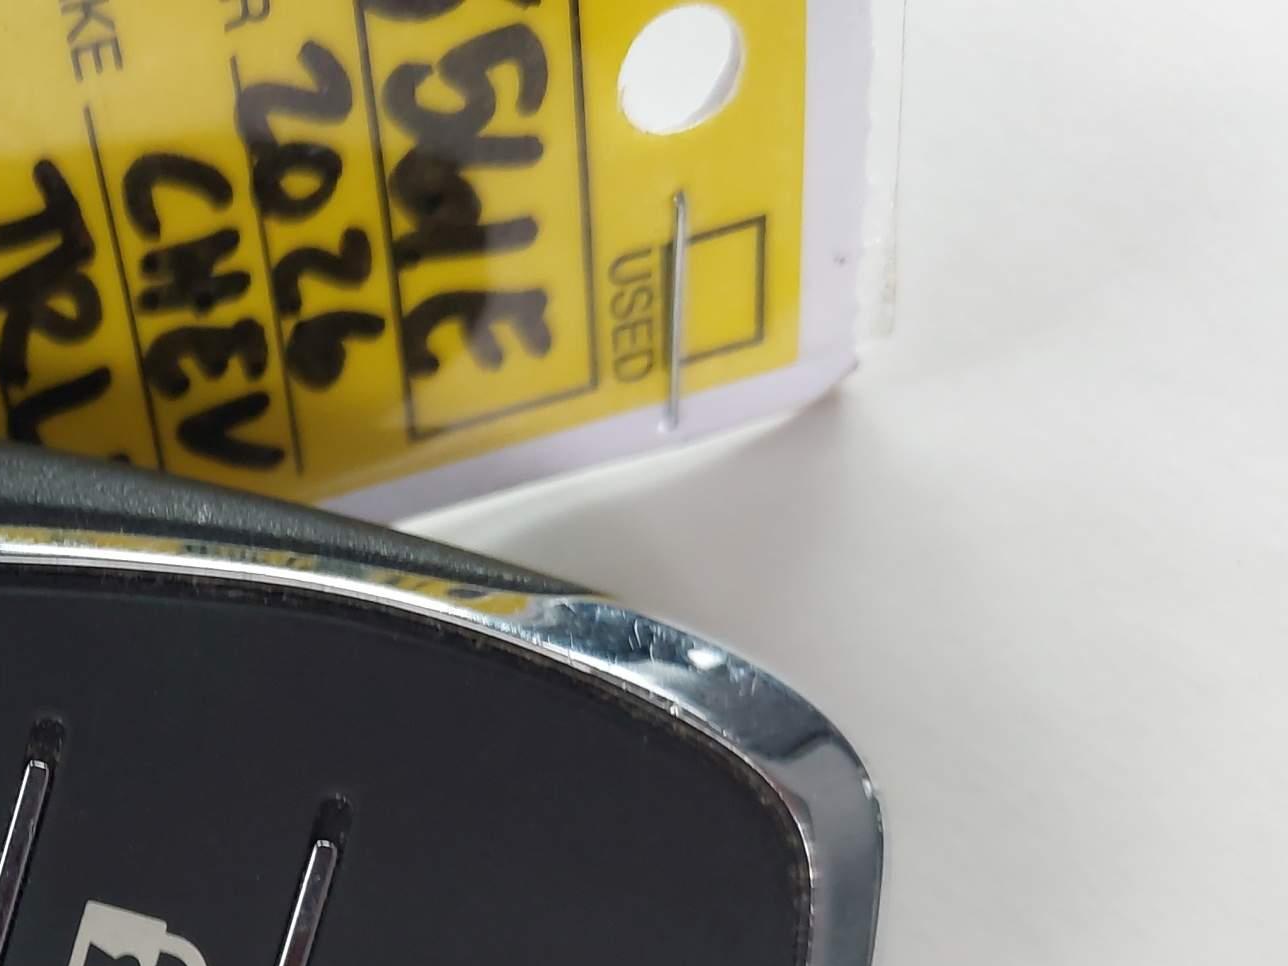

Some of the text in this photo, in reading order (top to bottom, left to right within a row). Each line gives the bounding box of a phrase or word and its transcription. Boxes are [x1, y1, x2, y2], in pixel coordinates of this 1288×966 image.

[60, 0, 123, 83] KE
[121, 151, 285, 469] CHEV
[234, 40, 386, 391] 2026
[608, 246, 654, 384] USED
